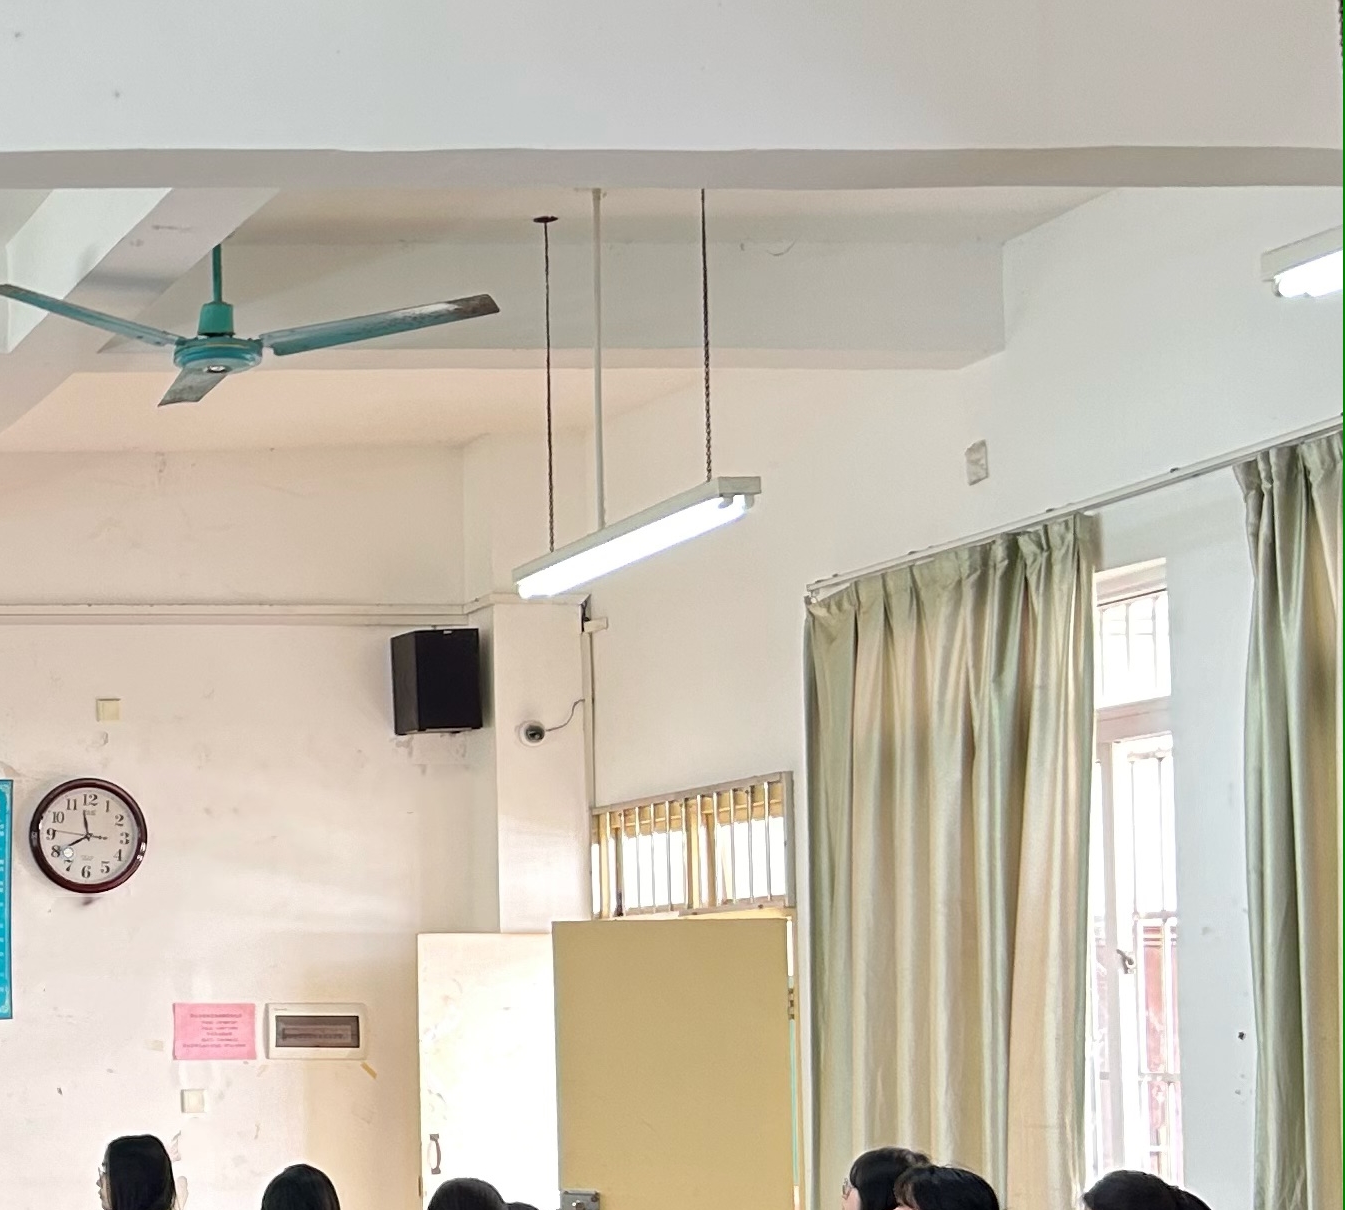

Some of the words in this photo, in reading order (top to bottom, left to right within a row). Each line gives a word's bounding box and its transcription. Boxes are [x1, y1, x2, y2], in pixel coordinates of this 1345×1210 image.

[66, 798, 77, 811] 11
[83, 793, 98, 807] 12
[105, 799, 110, 813] 1
[52, 811, 65, 824] 10
[114, 814, 124, 826] 2
[46, 828, 56, 840] 9
[119, 832, 130, 845] 3
[51, 845, 61, 858] 8
[113, 849, 122, 861] 4
[64, 859, 73, 872] 7
[81, 865, 91, 878] 6
[100, 861, 110, 874] 5
